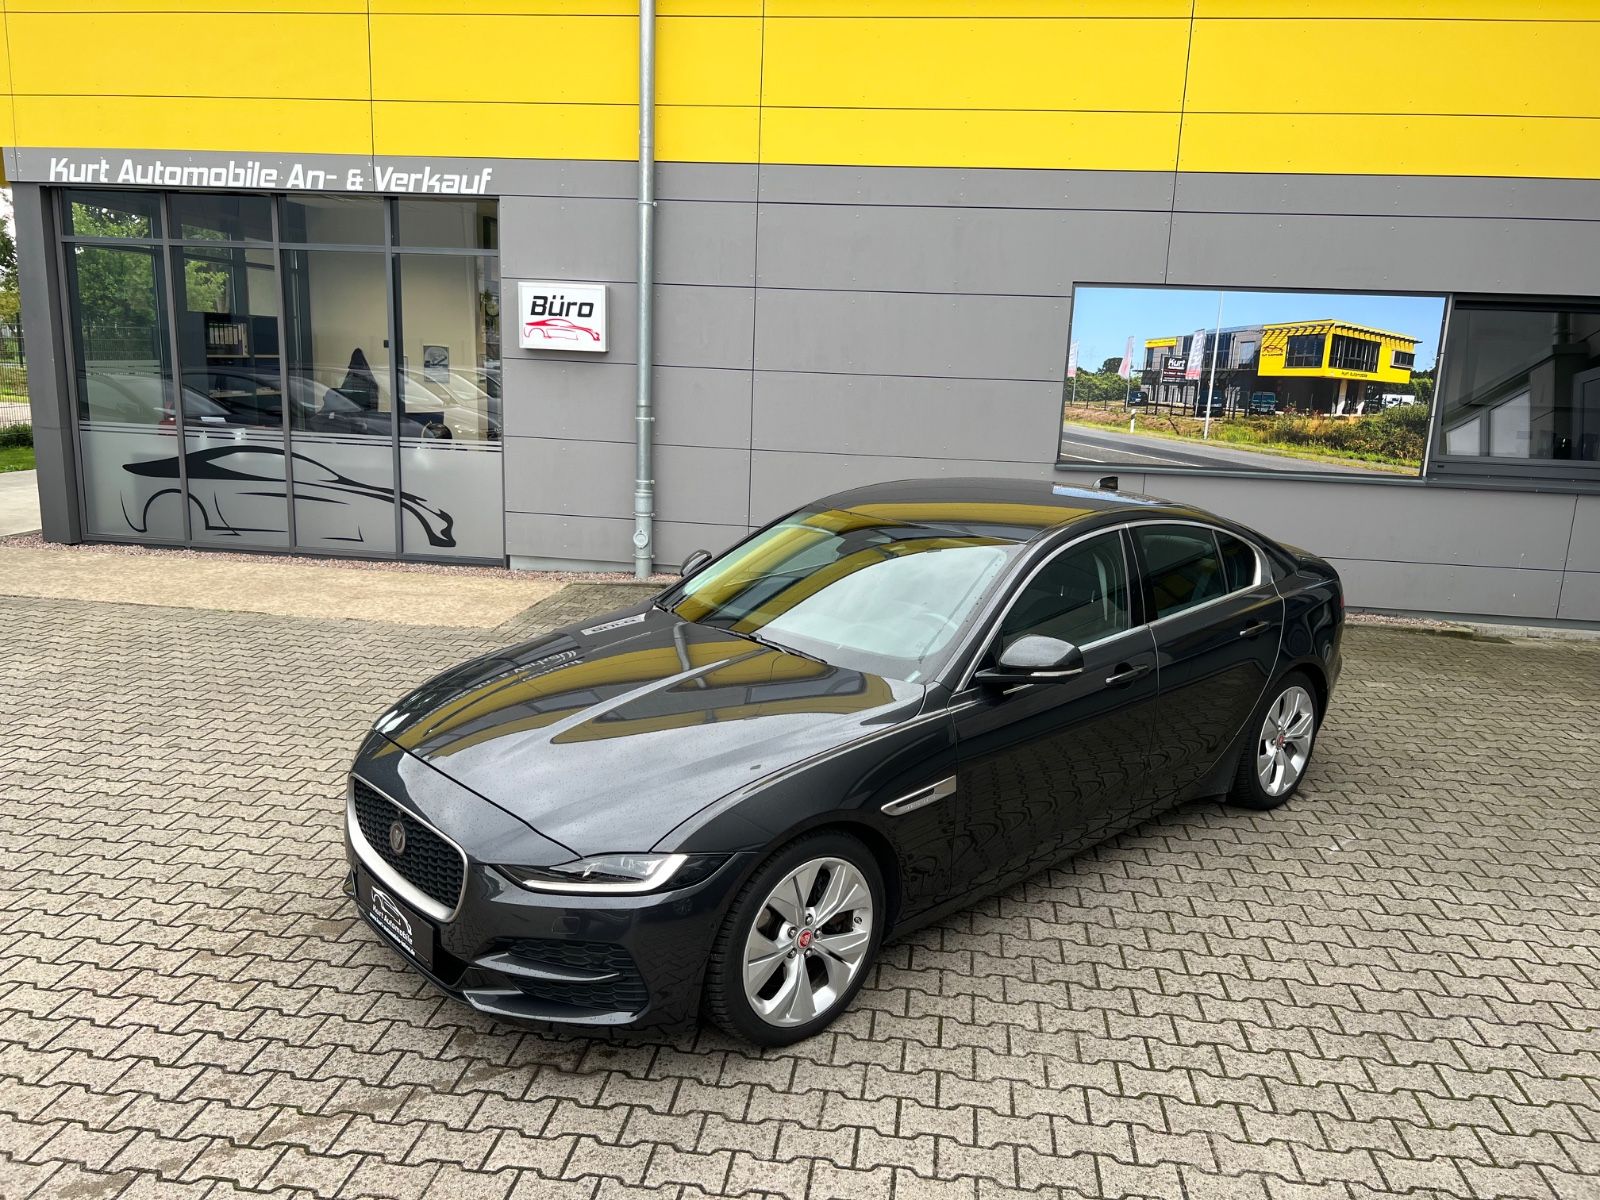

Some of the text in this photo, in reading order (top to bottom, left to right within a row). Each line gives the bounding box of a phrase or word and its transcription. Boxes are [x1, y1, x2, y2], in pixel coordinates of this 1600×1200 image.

[50, 157, 492, 194] Kurt Automobile An- & Verkauf
[530, 295, 594, 318] Büro
[1168, 358, 1185, 368] Kurt
